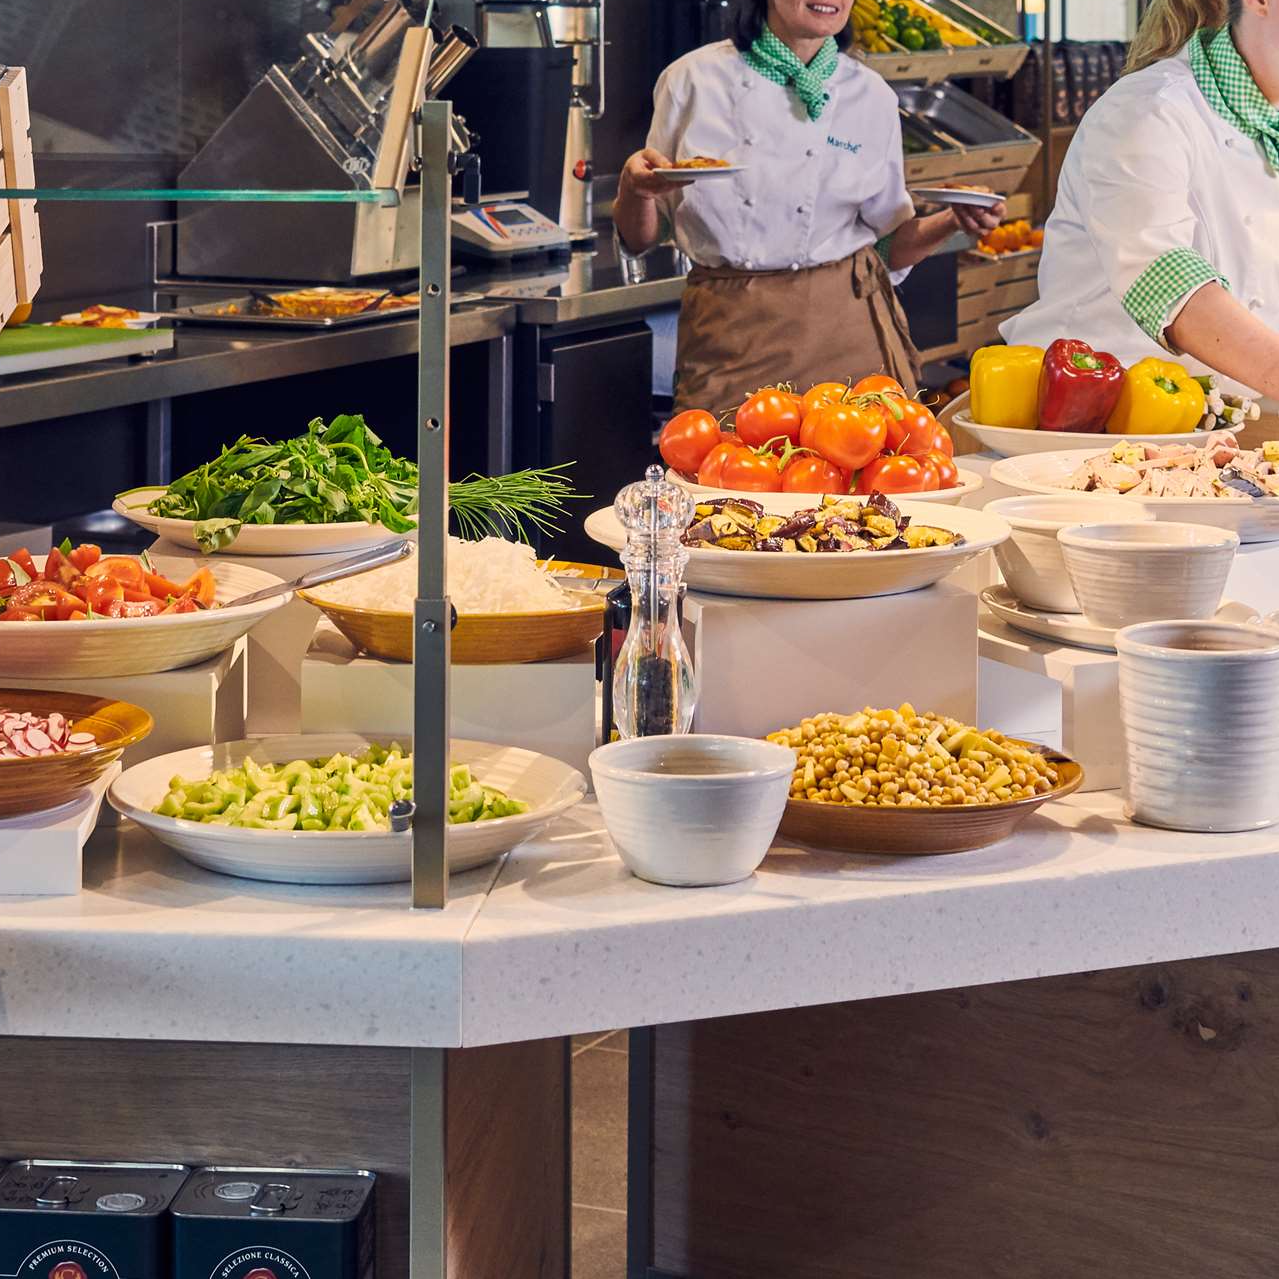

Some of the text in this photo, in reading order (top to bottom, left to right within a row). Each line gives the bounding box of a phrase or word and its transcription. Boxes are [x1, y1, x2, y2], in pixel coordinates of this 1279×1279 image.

[28, 1245, 109, 1273] PREMIUM SELECTION
[221, 1251, 300, 1278] SELEZIONE CLASSICA
